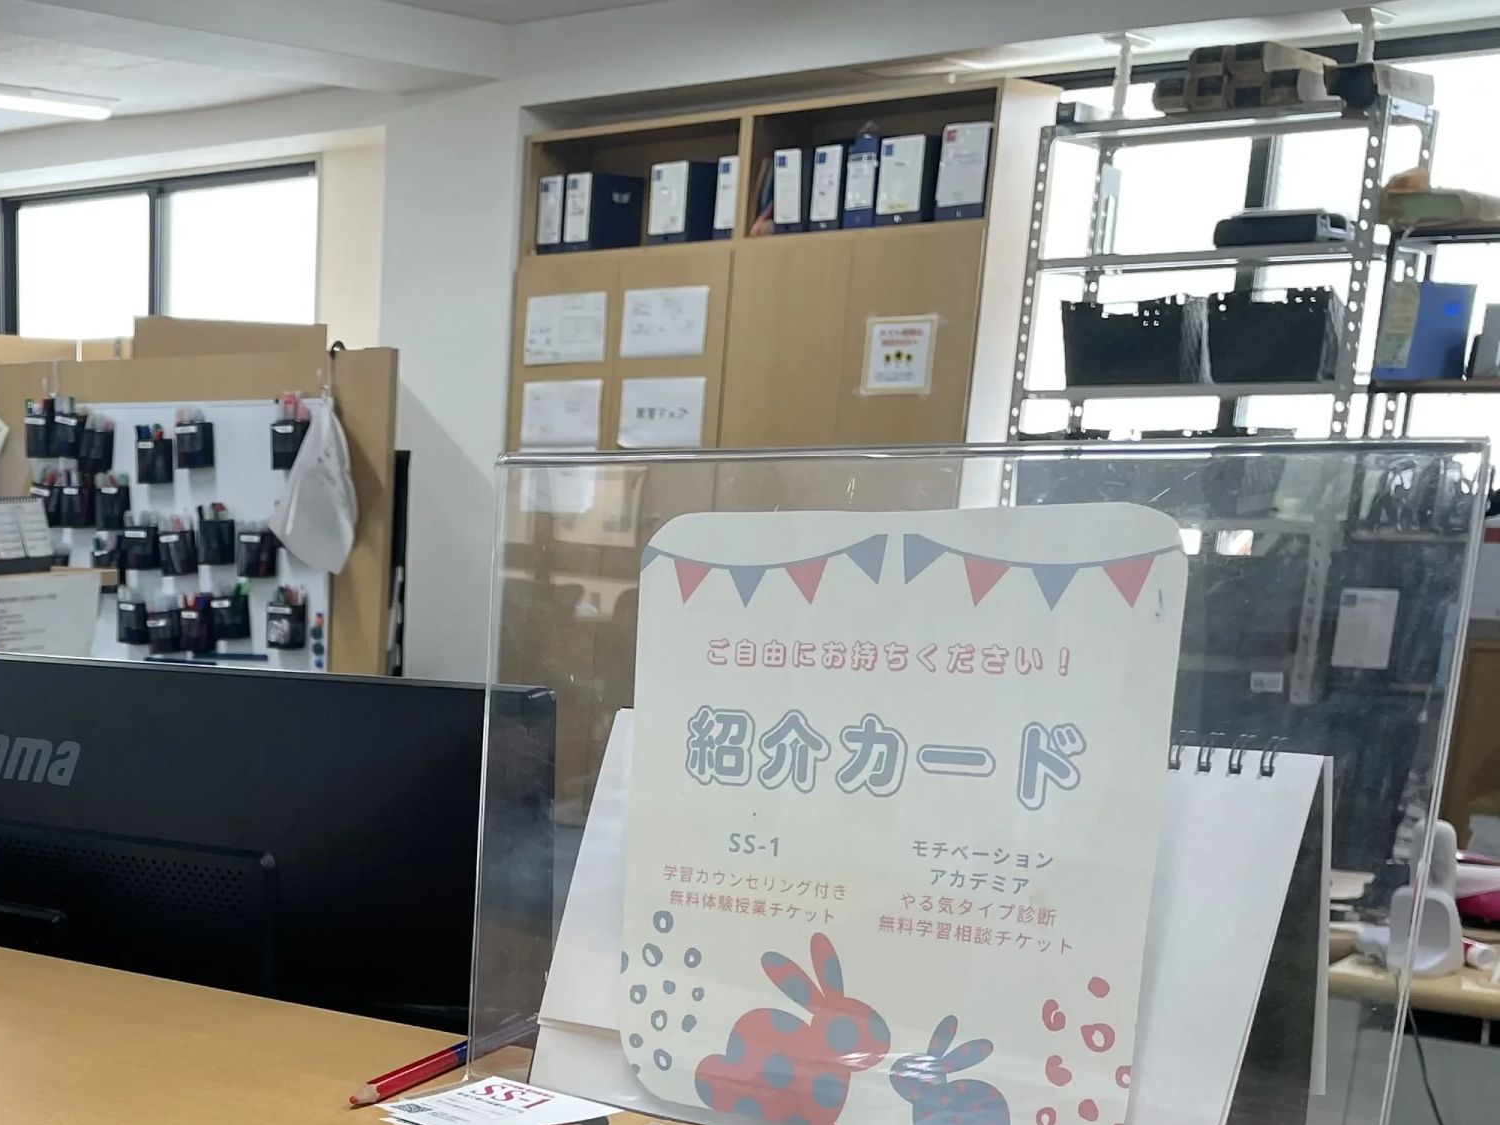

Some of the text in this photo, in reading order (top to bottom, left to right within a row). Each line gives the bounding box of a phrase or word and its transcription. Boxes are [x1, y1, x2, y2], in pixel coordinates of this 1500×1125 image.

[706, 638, 1071, 676] ご自由にお持ちください！
[685, 704, 1087, 812] 紹介カード
[728, 832, 781, 857] SS-1
[912, 839, 1054, 869] モチベーション
[662, 864, 847, 901] 学習カウンセリング付き
[929, 868, 1031, 895] アカデミア
[669, 889, 836, 924] 無料体験授業チケット
[900, 892, 1057, 928] やる気タイプ診断
[878, 914, 1073, 955] 無料学習相談チケット
[473, 1083, 553, 1110] SS-1
